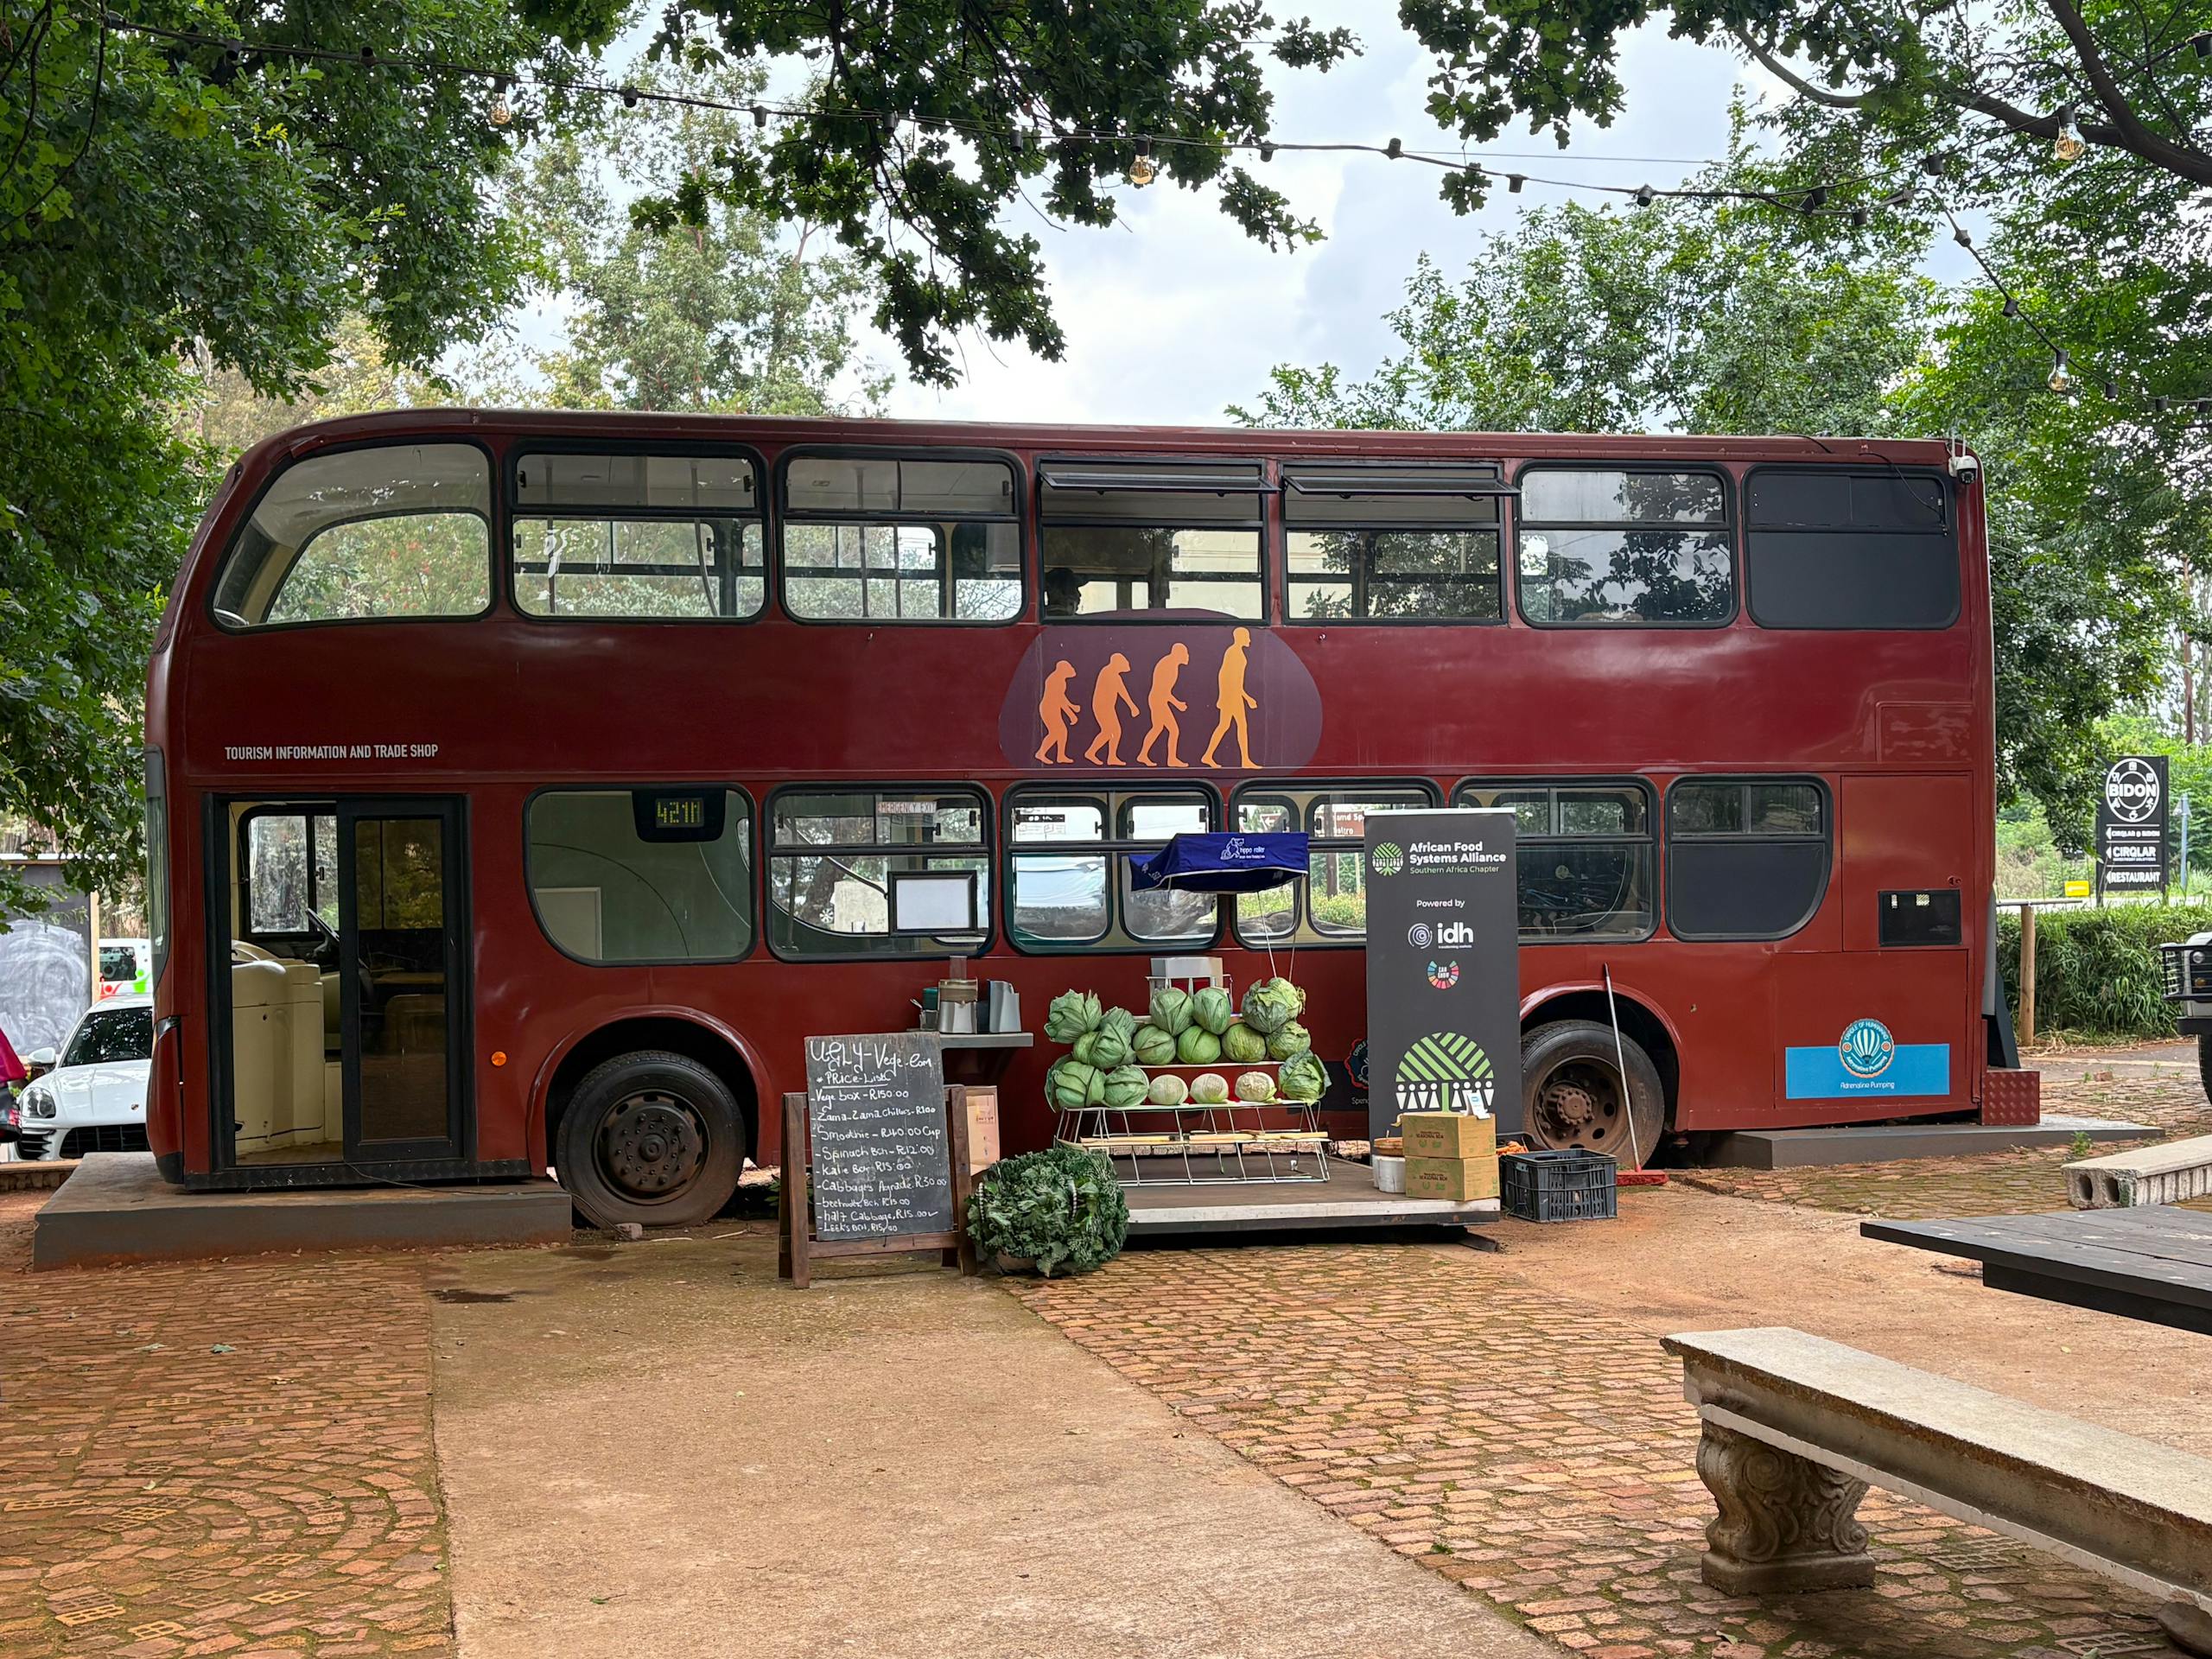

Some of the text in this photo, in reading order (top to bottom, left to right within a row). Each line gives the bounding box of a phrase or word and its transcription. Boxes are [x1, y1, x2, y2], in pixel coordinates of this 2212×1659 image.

[225, 744, 439, 760] TOURISM INFORMATION AND TRADE SHOP
[2108, 784, 2157, 797] BIDON
[877, 802, 936, 813] EMERGENCY EXIT
[1409, 841, 1483, 853] African Food
[2113, 847, 2157, 857] CIRQLAR
[1409, 852, 1506, 866] Systems Alliance
[1470, 866, 1499, 874] Chapter
[2112, 872, 2160, 882] RESTAURANT
[1454, 899, 1465, 908] by
[1437, 922, 1474, 944] idh
[839, 1090, 861, 1100] box
[922, 1126, 941, 1140] Cup
